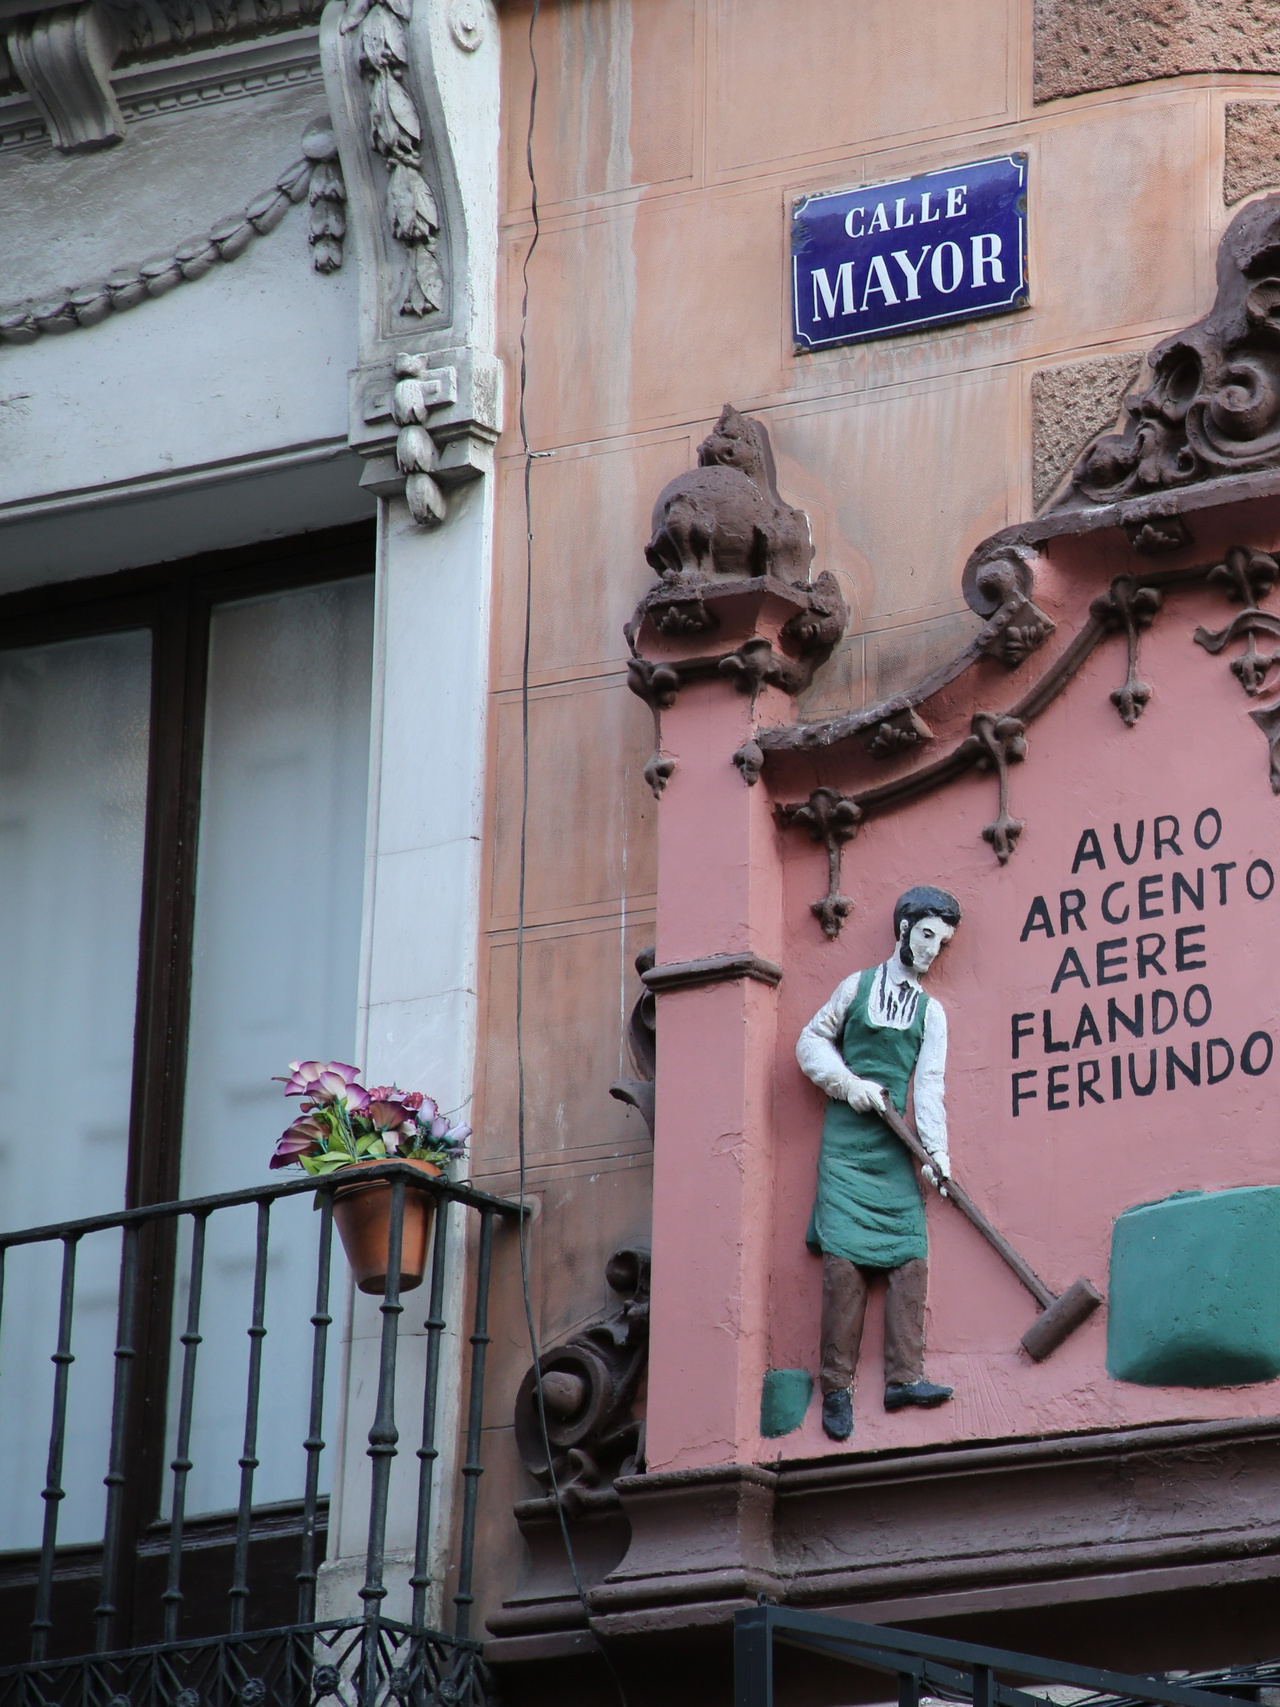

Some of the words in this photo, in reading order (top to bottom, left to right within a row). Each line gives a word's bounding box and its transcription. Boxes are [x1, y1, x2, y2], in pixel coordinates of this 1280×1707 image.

[844, 184, 968, 238] CALLE
[810, 233, 1006, 322] MAYOR
[1071, 807, 1222, 874] AURO
[1050, 924, 1207, 994] AERE
[1011, 983, 1212, 1060] FLANDO
[1011, 1030, 1274, 1118] FERIUNDO
